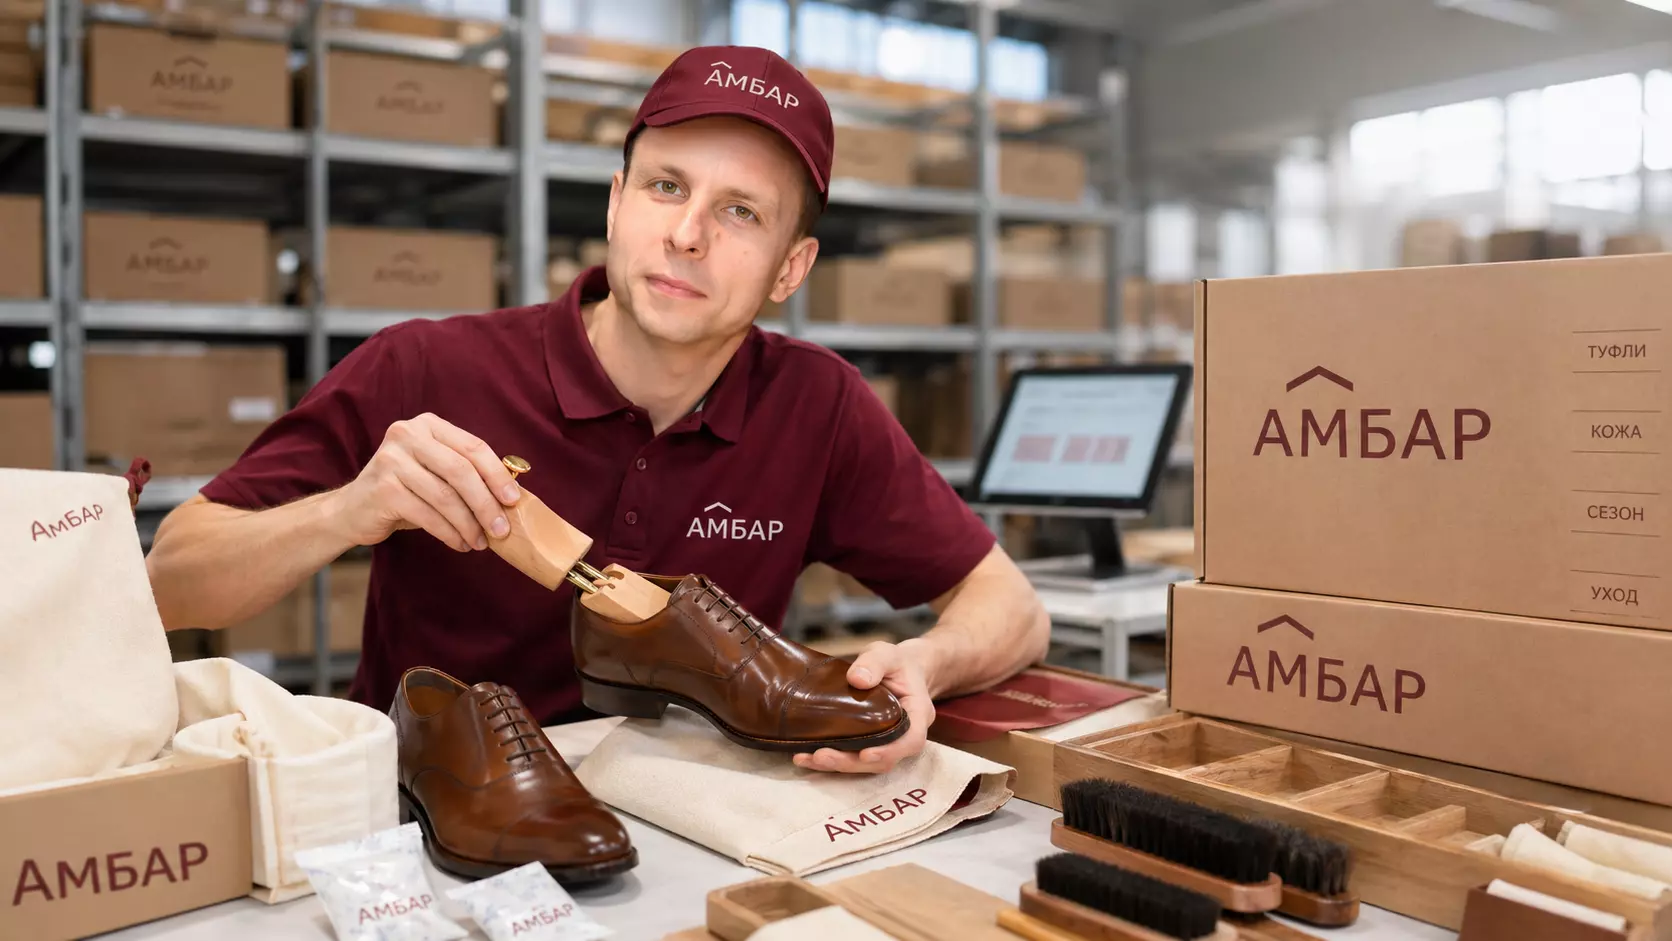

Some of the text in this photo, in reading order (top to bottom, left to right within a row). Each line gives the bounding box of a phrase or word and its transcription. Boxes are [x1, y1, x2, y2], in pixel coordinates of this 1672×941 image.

[704, 69, 800, 108] АМБАР
[1588, 344, 1646, 358] ТУФЛИ
[1252, 408, 1491, 460] АМБАР
[1591, 424, 1642, 439] КОЖА
[686, 517, 784, 541] АМБАР
[1587, 505, 1644, 521] СЕЗОН
[1591, 586, 1638, 606] УХОД
[1226, 645, 1426, 714] АМБАР
[824, 788, 927, 842] АМБАР
[12, 842, 208, 906] АМБАР
[359, 894, 432, 925] АМБАР
[512, 903, 573, 937] АМБАР
